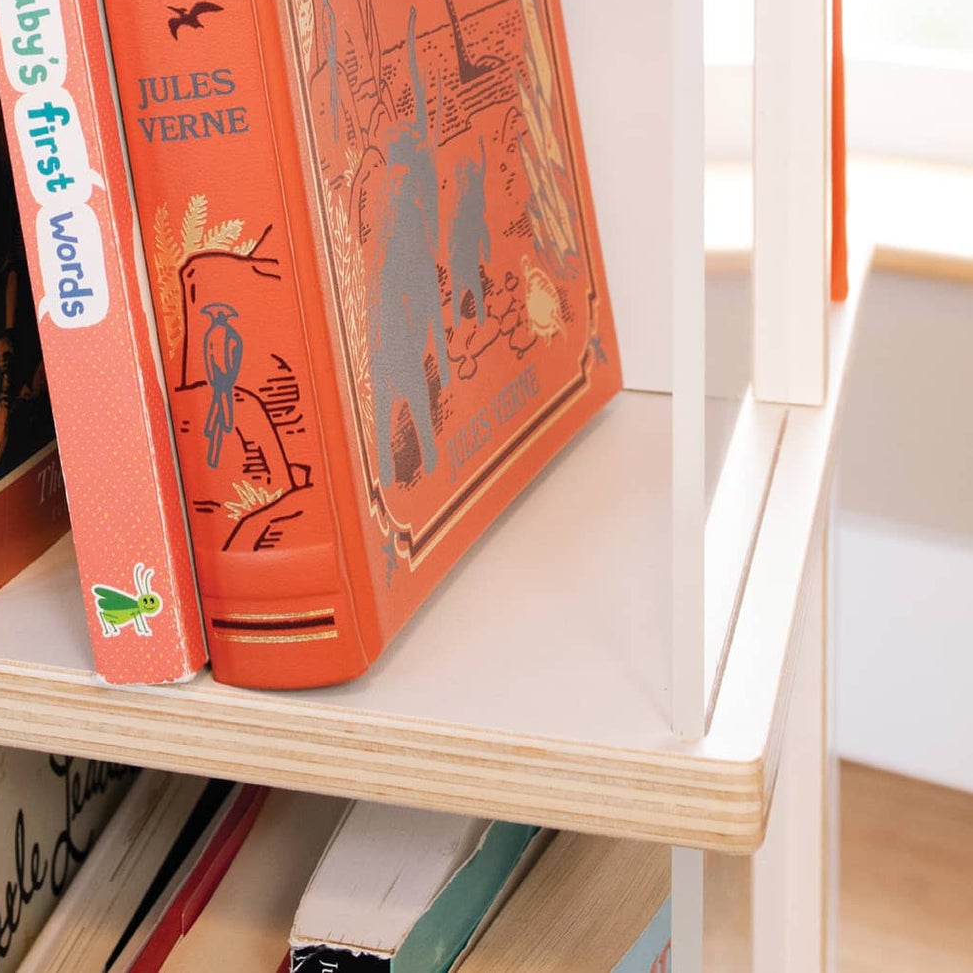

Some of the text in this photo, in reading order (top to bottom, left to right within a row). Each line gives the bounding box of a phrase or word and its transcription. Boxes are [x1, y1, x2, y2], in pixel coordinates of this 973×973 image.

[137, 107, 250, 144] VERNE
[138, 68, 236, 111] JULES
[27, 100, 75, 194] first
[50, 211, 94, 318] words
[447, 363, 540, 484] JULES VERNE
